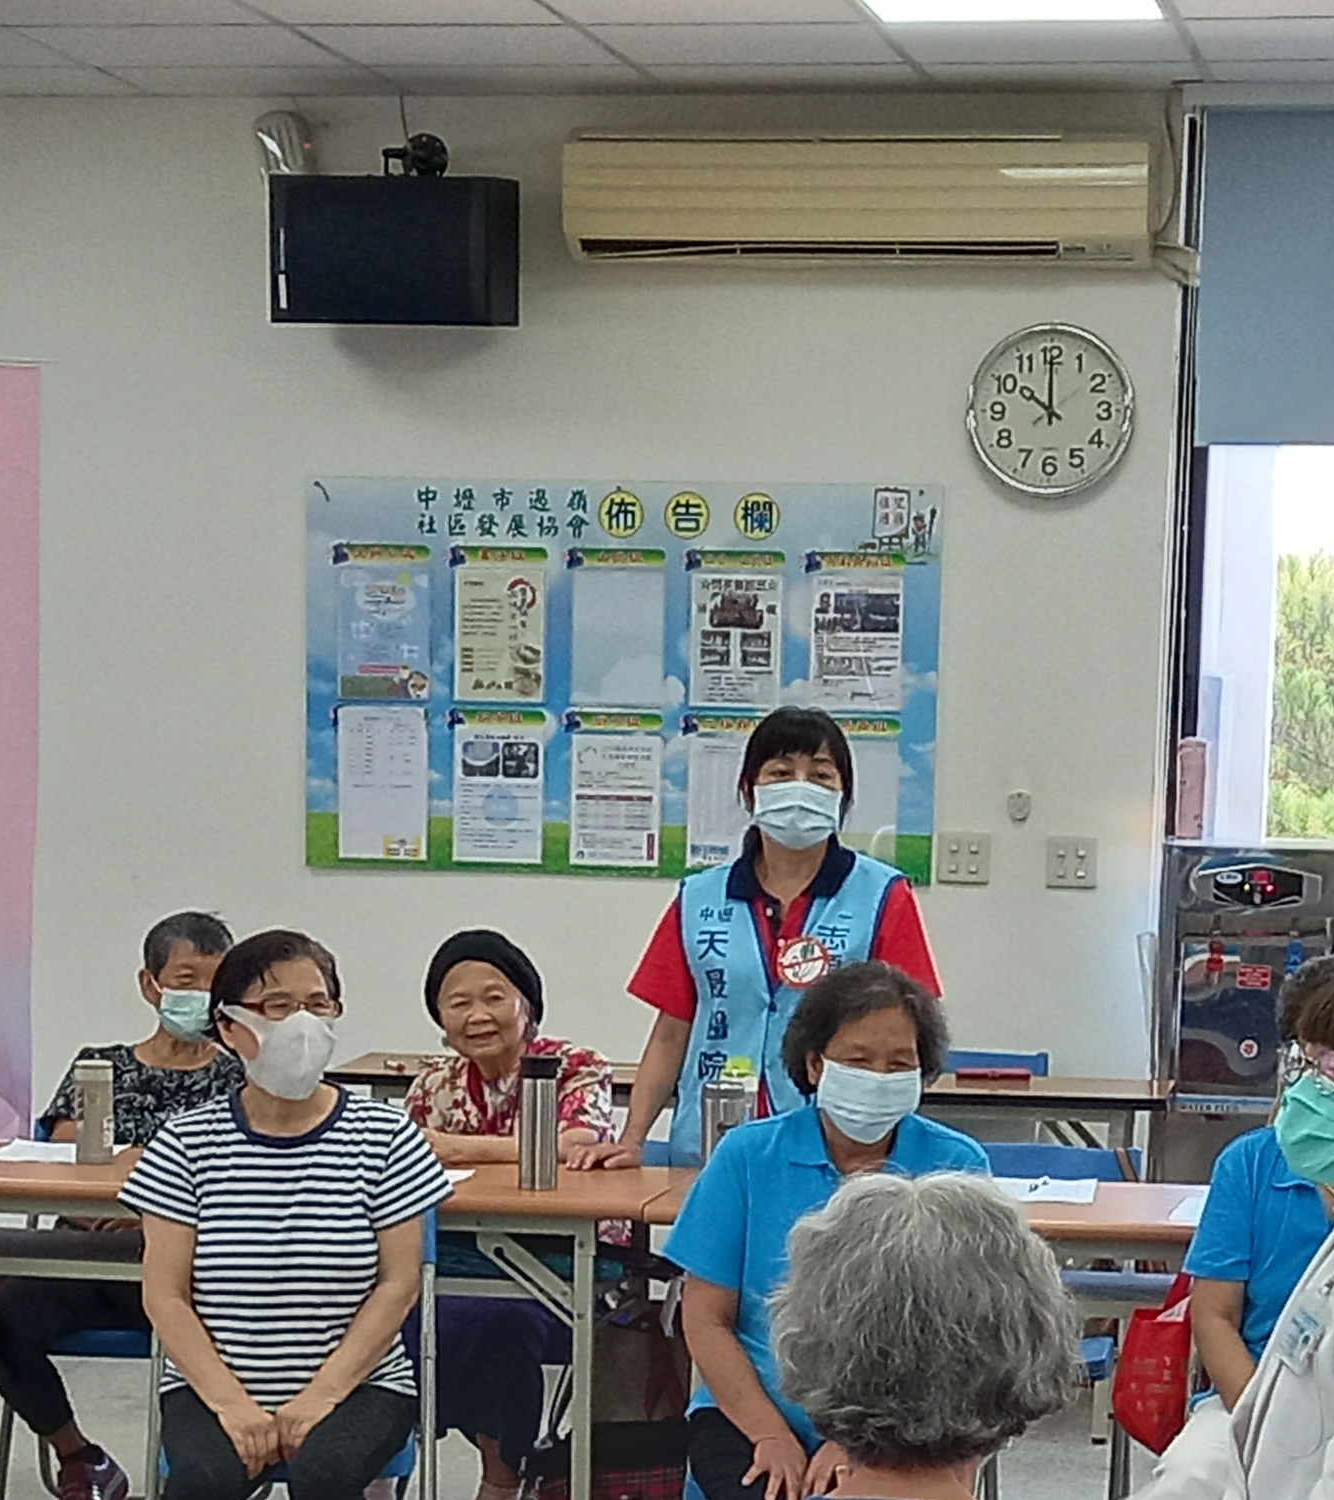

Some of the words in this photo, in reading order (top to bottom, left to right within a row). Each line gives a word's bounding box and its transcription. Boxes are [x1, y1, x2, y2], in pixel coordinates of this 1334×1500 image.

[1017, 354, 1033, 373] 11
[1041, 346, 1063, 365] 12
[1075, 353, 1083, 373] 1
[995, 374, 1017, 394] 10
[1090, 374, 1105, 393] 2
[990, 401, 1005, 421] 9
[1096, 401, 1112, 420] 3
[996, 428, 1012, 448] 8
[1088, 429, 1104, 448] 4
[1018, 448, 1033, 468] 7
[1042, 456, 1057, 476] 6
[1069, 448, 1084, 468] 5
[605, 497, 774, 534] 佈告欄
[417, 513, 590, 539] 社區發展協會
